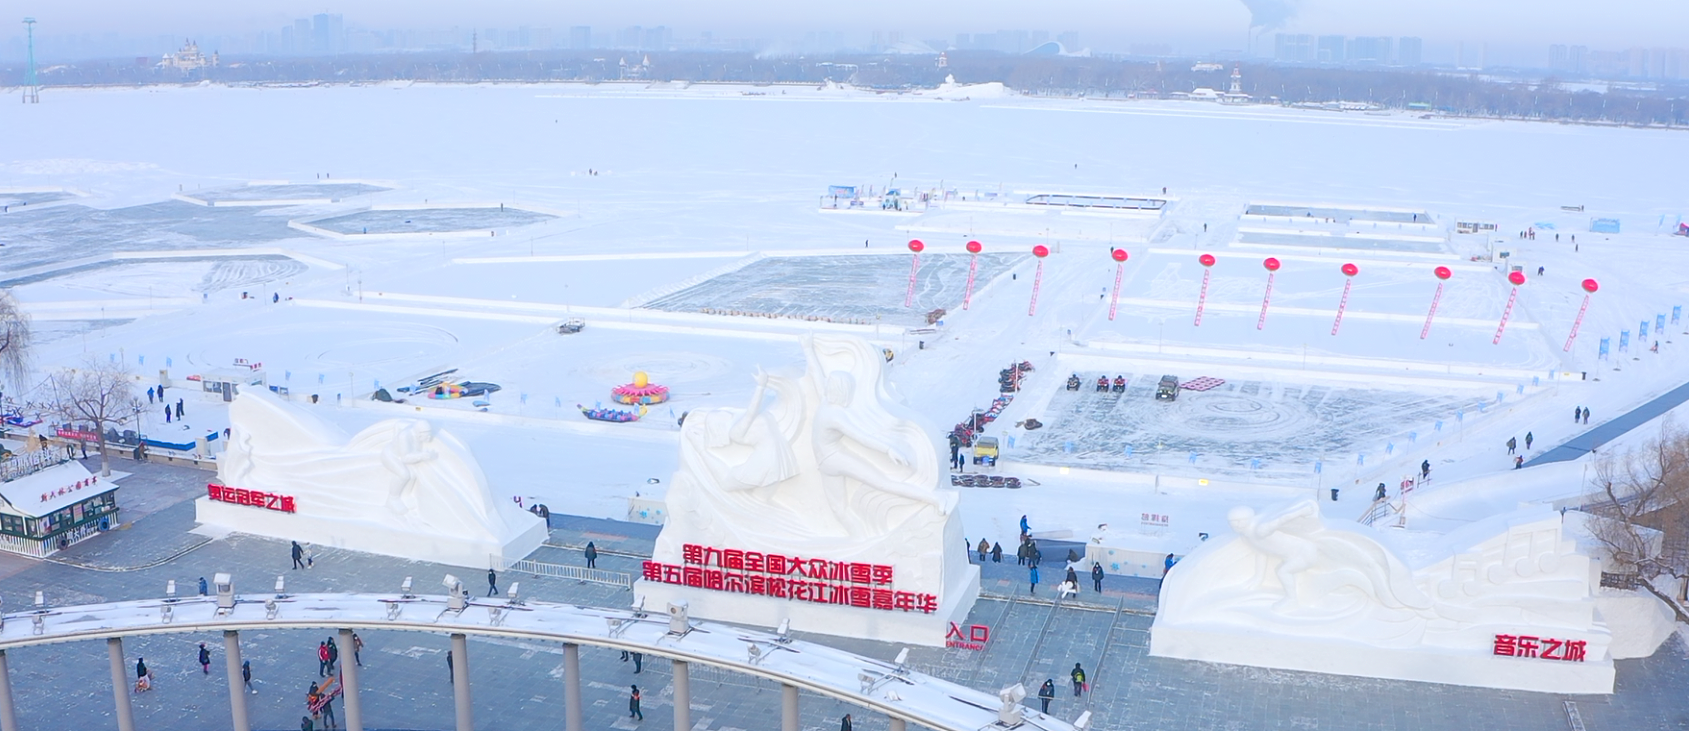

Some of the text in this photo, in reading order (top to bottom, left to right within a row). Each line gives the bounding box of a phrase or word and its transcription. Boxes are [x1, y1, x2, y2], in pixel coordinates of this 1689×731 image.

[207, 483, 297, 513] 奥运冠军之城
[682, 543, 894, 586] 第九届全国大众冰雪季
[642, 560, 939, 614] 第五届哈尔滨松花江冰雪嘉年华
[945, 621, 989, 643] 入口
[1492, 633, 1589, 662] 音乐之城
